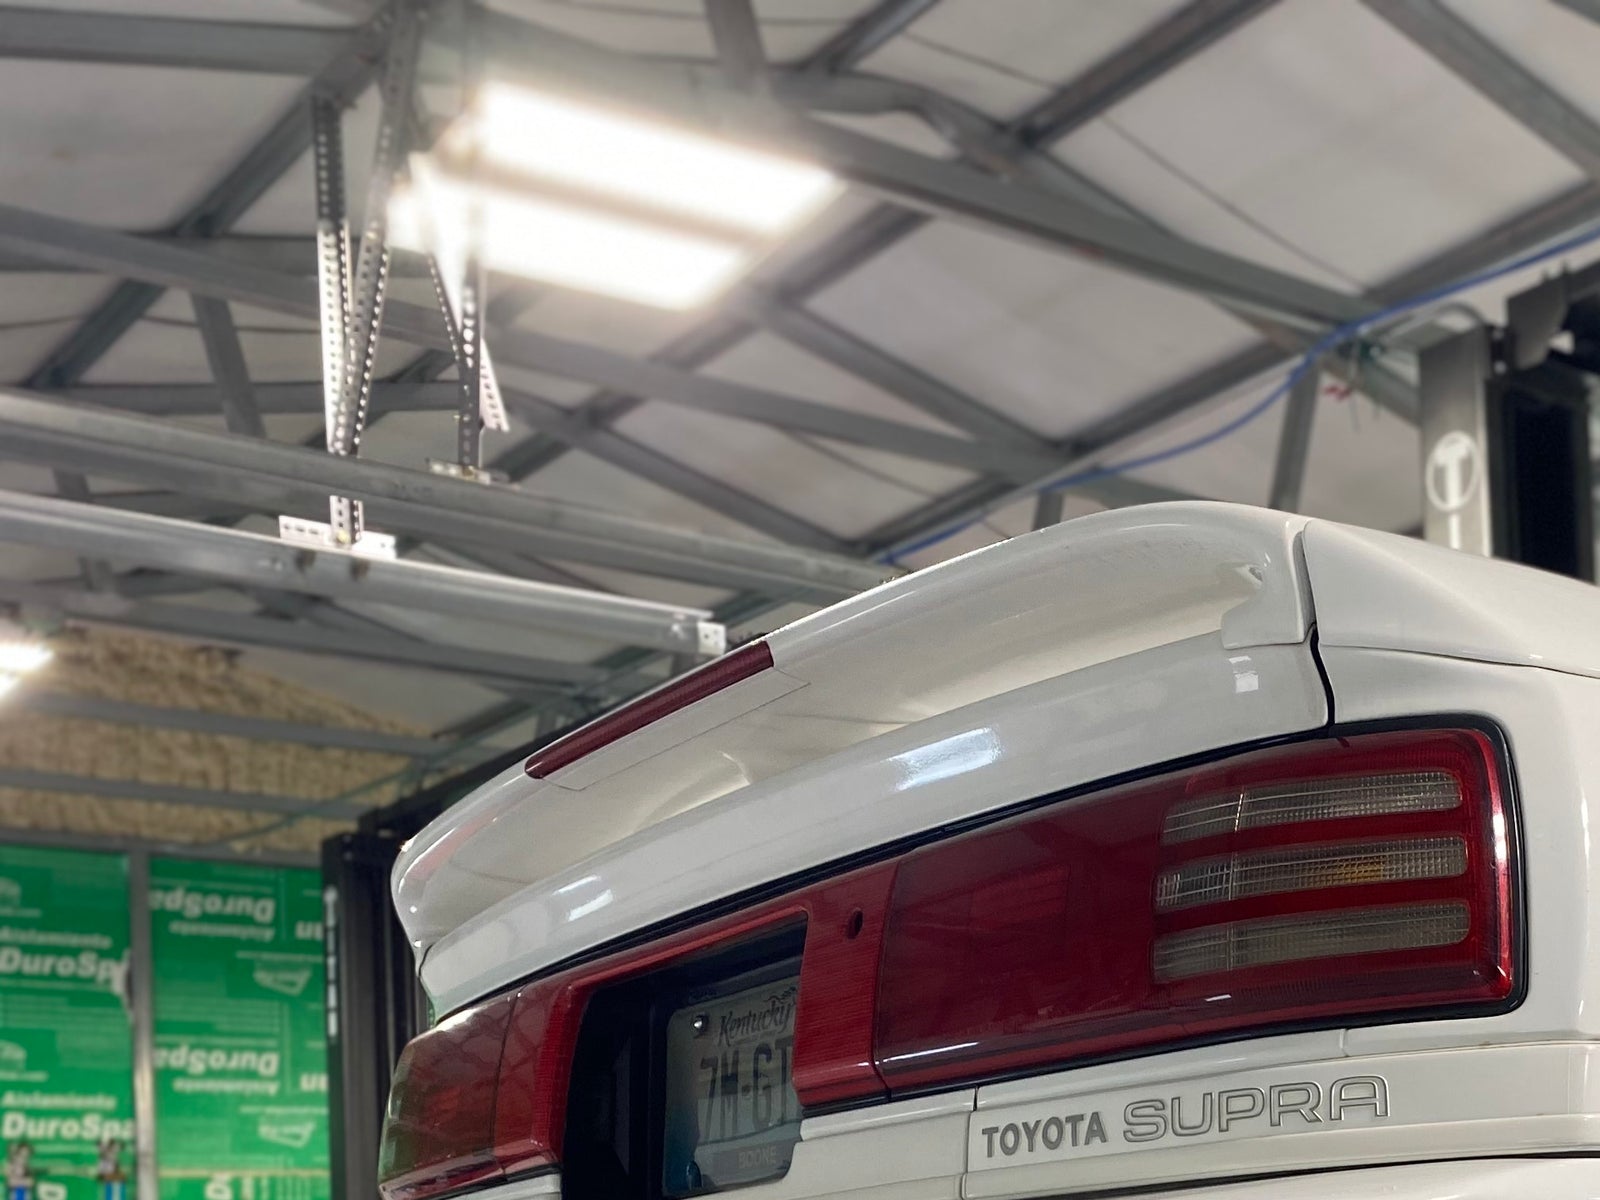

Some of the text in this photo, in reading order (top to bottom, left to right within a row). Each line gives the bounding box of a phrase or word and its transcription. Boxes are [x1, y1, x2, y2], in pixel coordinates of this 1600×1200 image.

[150, 888, 276, 922] DuroSpa
[0, 949, 124, 987] DuroSp
[717, 1001, 790, 1046] Kentucky
[152, 1044, 280, 1077] DuroSpa
[699, 1039, 794, 1142] 7M-GT
[2, 1111, 135, 1143] DuroSpa
[981, 1075, 1391, 1158] TOYOTA SUPRA
[738, 1146, 778, 1170] BOONE
